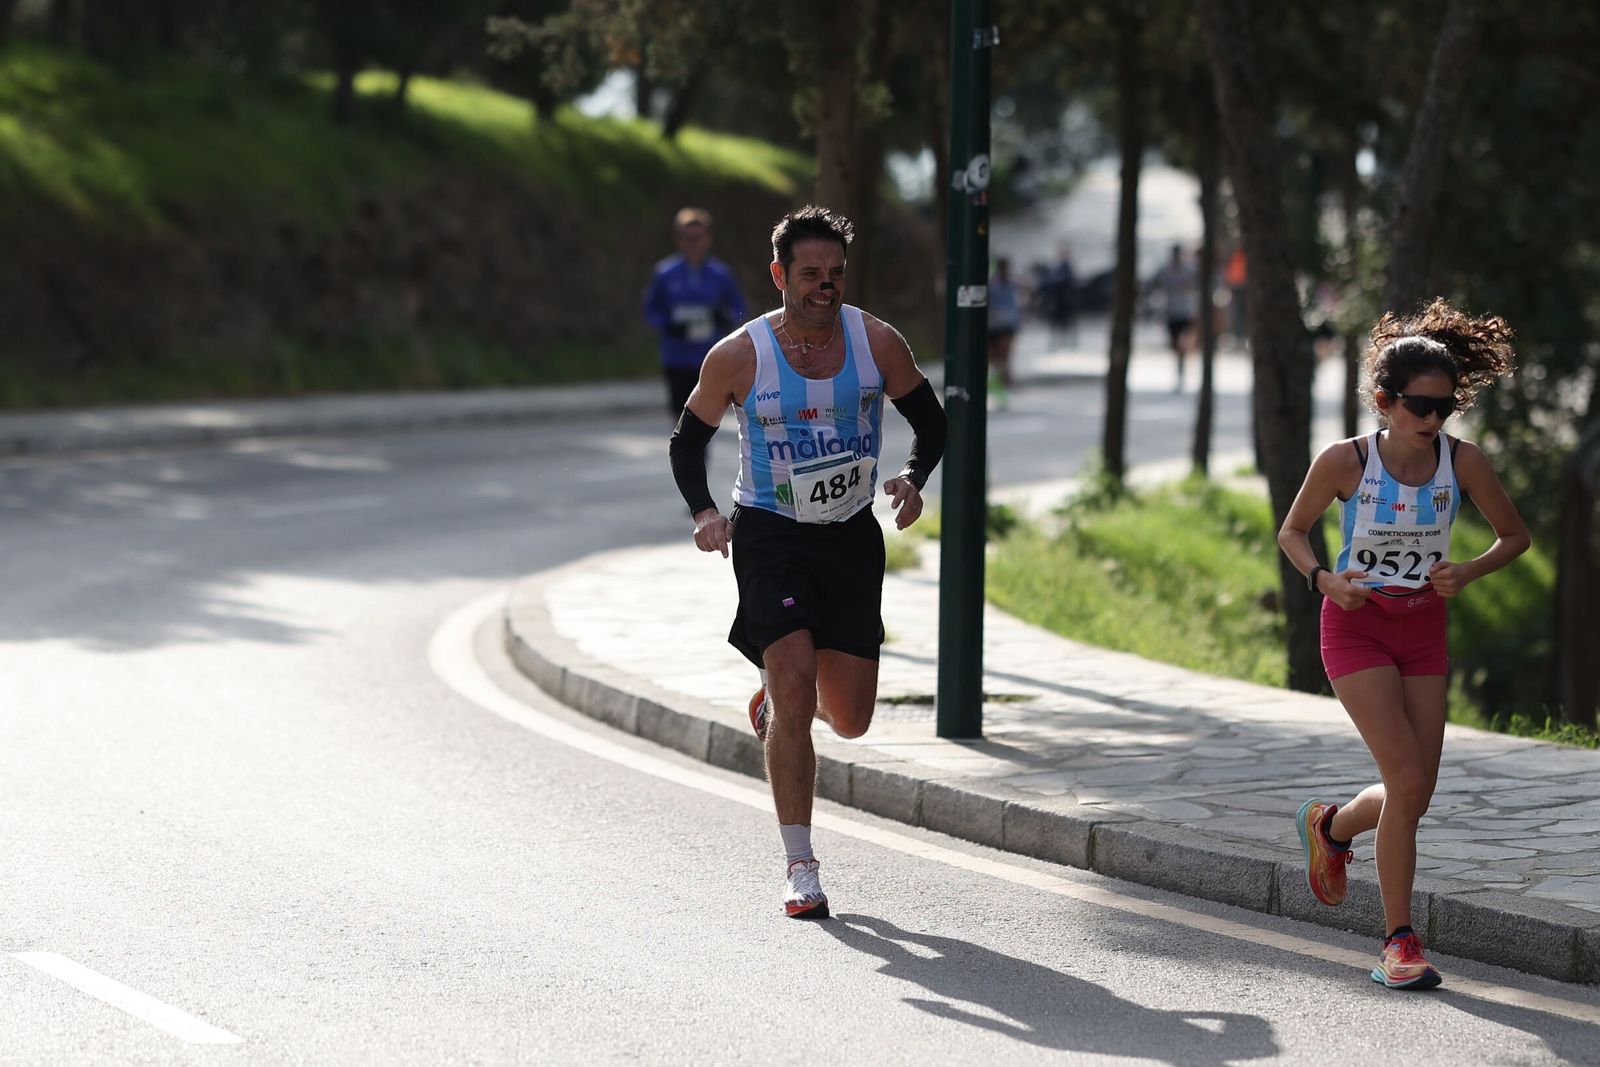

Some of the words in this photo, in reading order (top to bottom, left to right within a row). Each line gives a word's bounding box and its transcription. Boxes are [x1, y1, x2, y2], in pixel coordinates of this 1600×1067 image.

[756, 391, 781, 402] vive
[809, 465, 861, 504] 484
[1364, 477, 1386, 487] vive
[1368, 529, 1424, 538] COMPETICIONES
